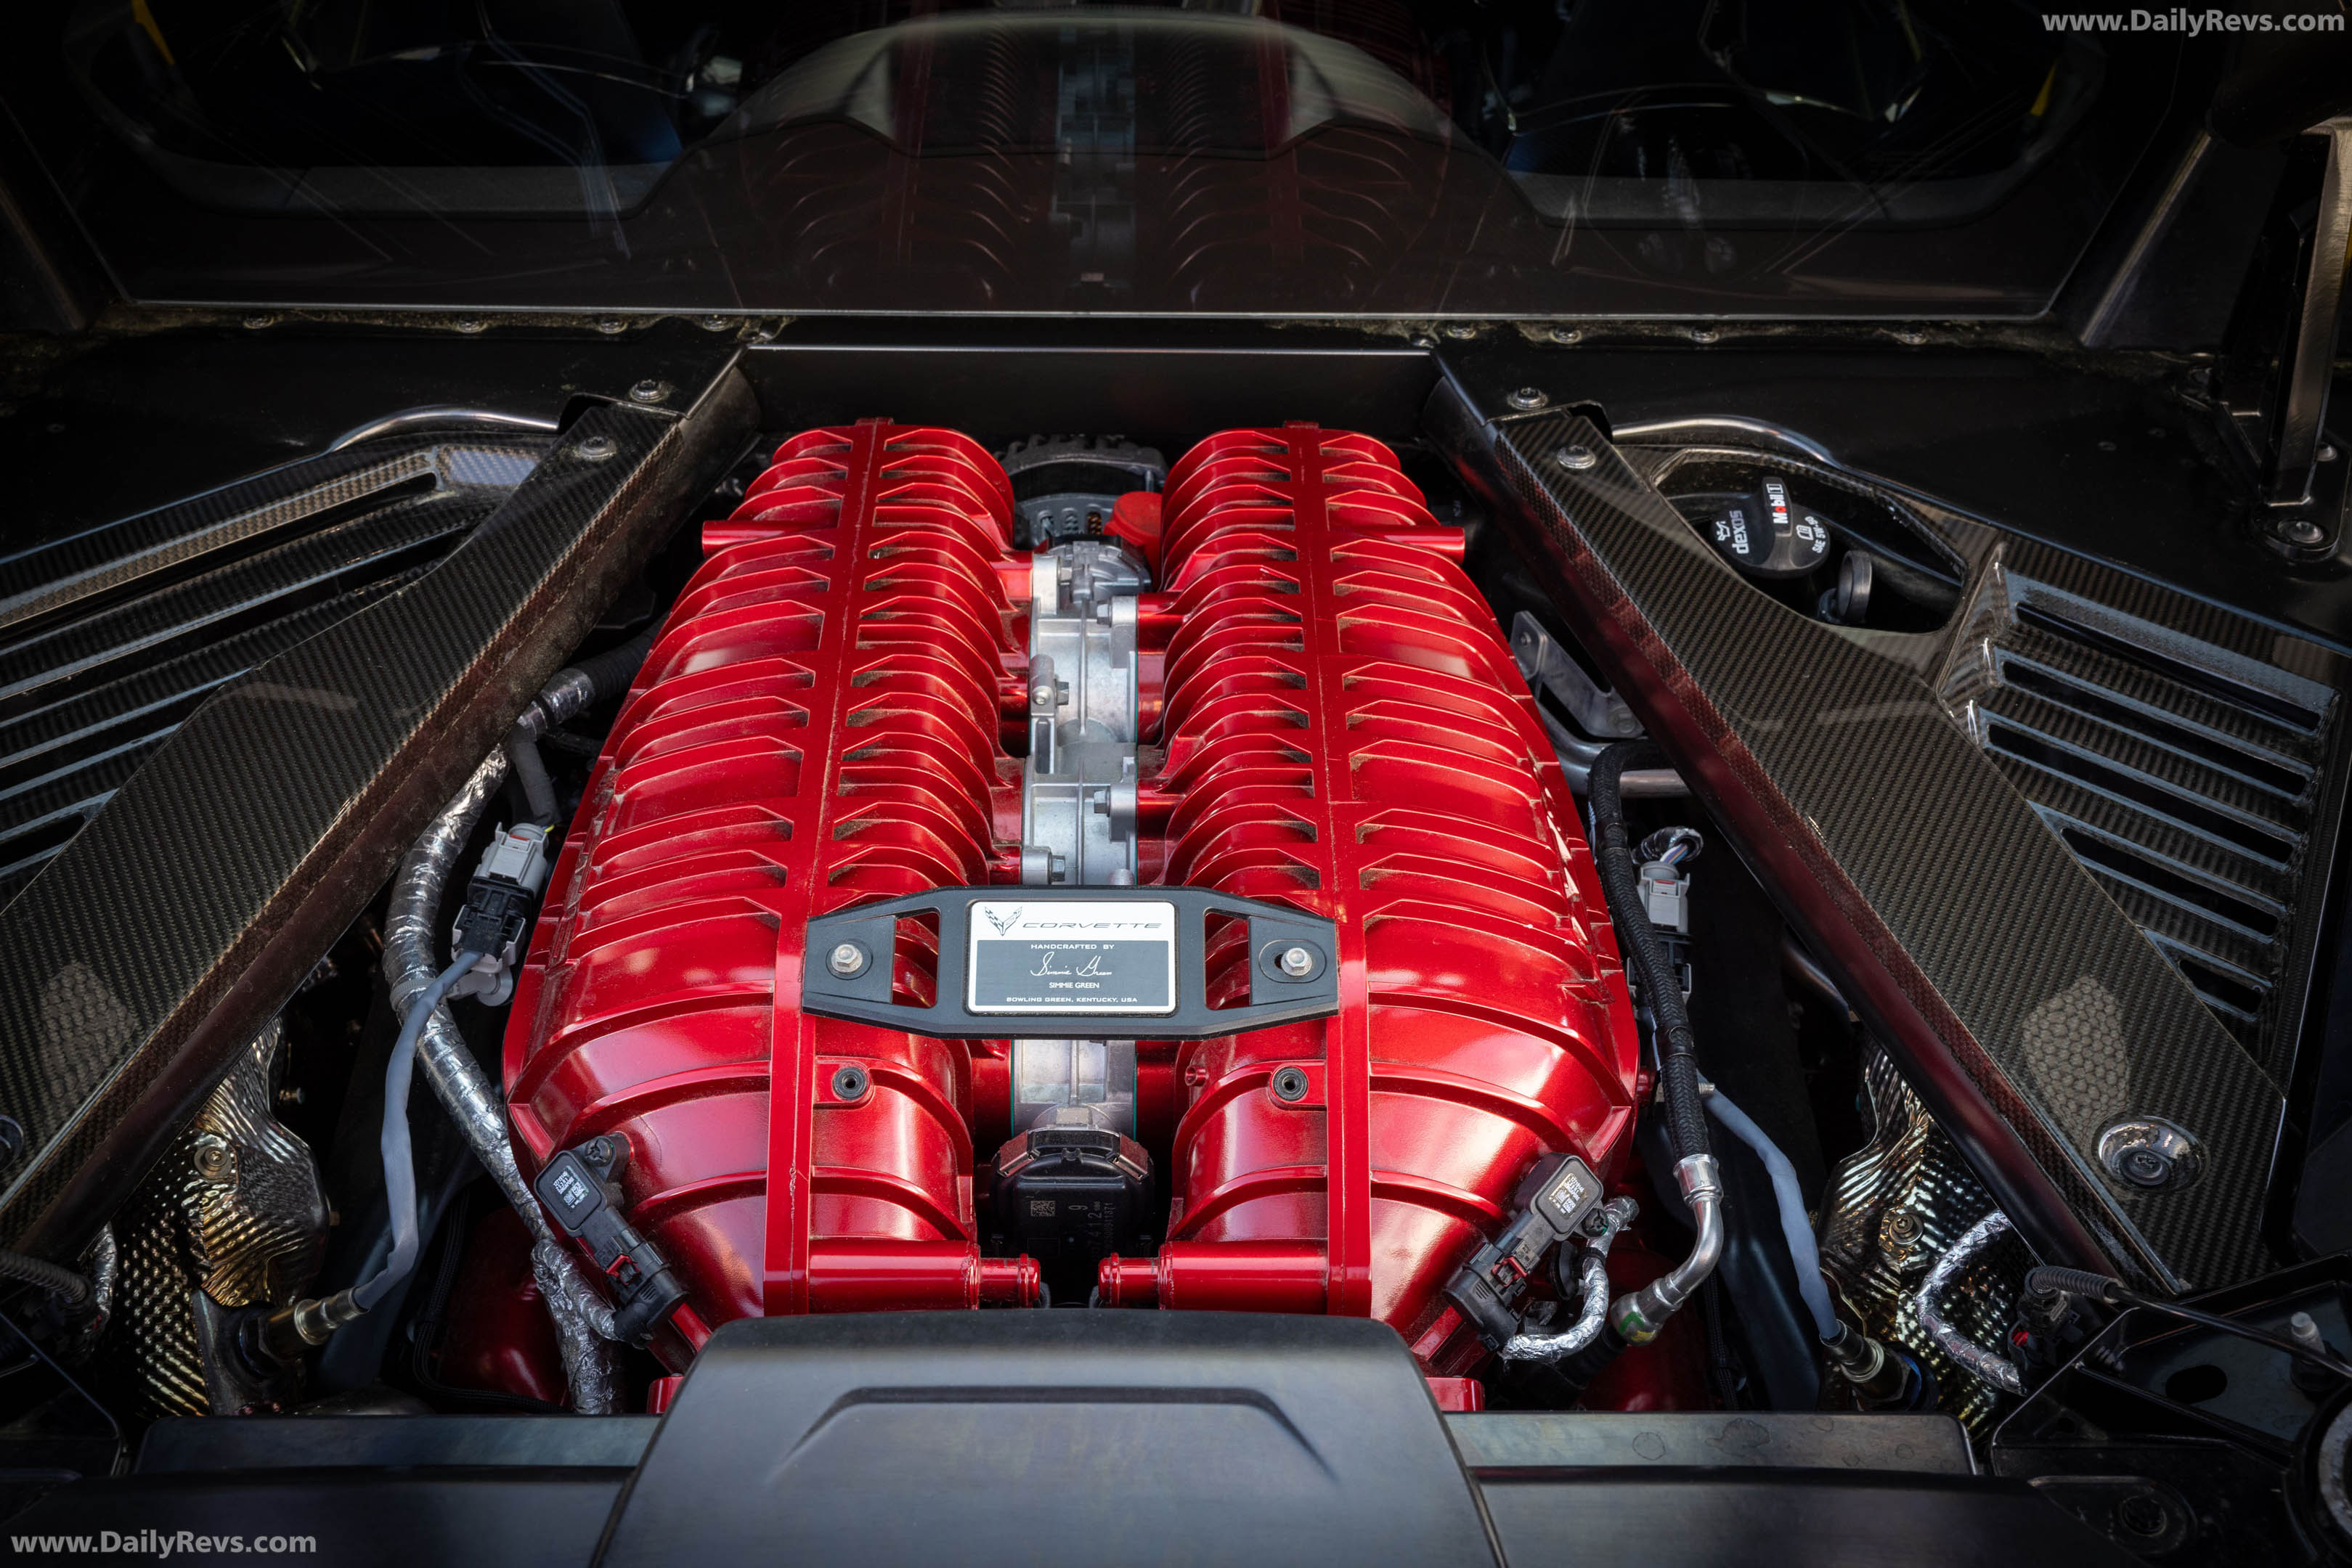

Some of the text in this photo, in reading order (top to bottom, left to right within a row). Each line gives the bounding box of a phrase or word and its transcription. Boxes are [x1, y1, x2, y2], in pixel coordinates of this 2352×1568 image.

[1769, 494, 1789, 524] Mobil
[1729, 510, 1749, 554] dexos
[1812, 540, 1826, 553] SAE
